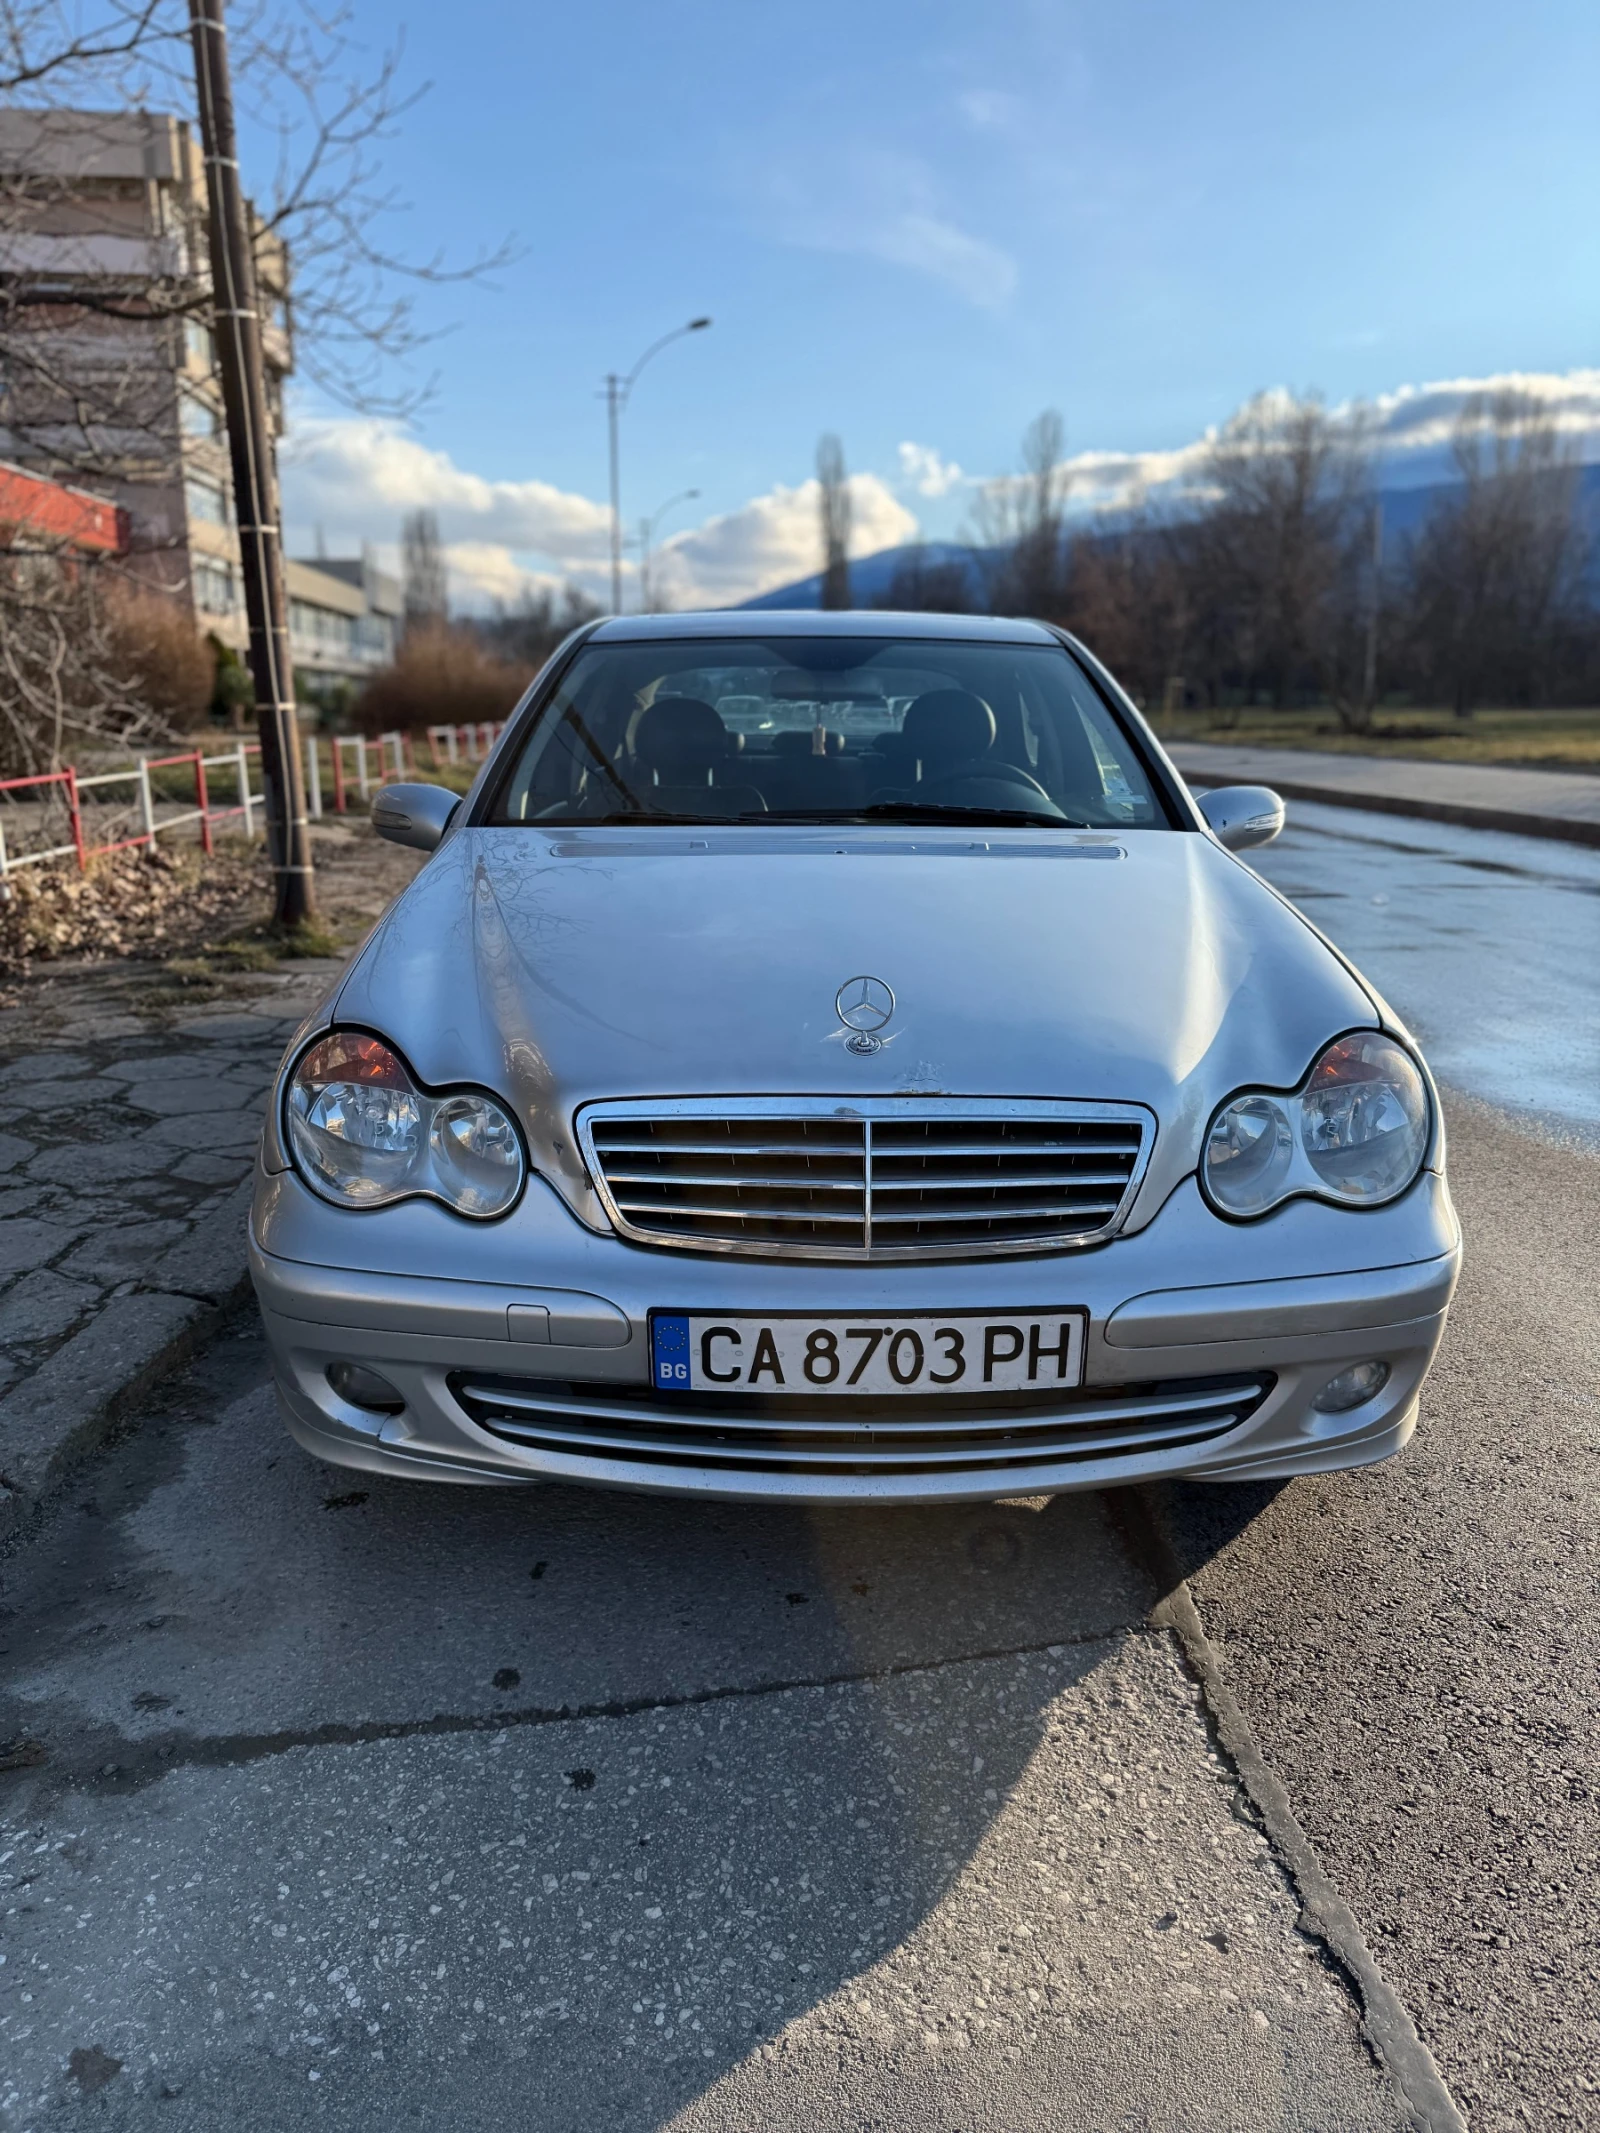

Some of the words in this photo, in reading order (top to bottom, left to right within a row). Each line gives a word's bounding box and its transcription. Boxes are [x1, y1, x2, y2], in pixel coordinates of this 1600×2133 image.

[660, 1363, 687, 1379] BG
[700, 1326, 786, 1384] CA
[803, 1327, 966, 1385] 8703
[983, 1323, 1071, 1382] PH
